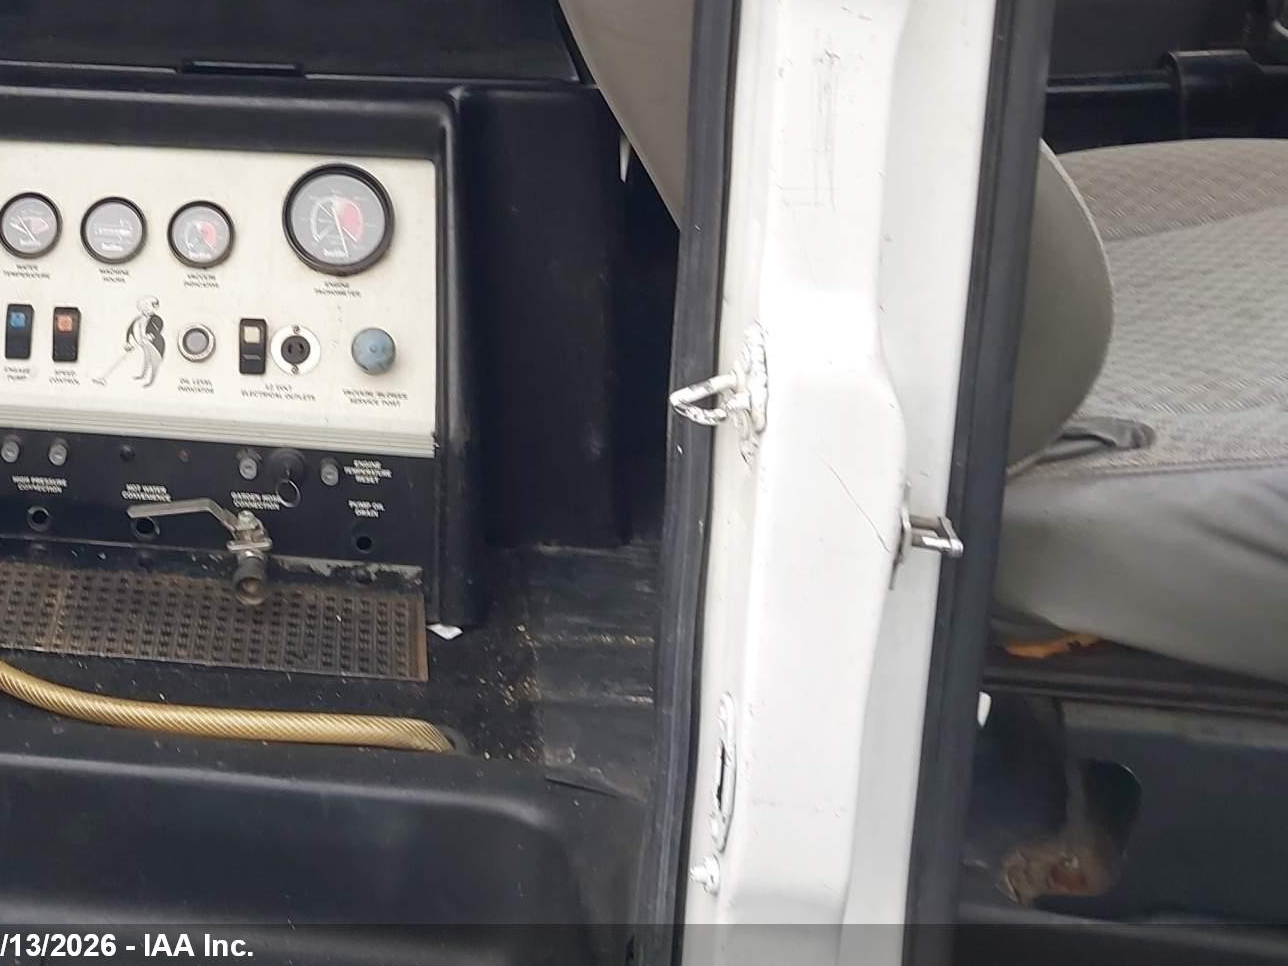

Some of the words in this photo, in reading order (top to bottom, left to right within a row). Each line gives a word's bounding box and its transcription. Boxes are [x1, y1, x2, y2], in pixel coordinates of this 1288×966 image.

[30, 476, 68, 487] PRESSURE
[125, 483, 141, 493] HOT
[142, 485, 167, 495] WATER
[232, 500, 281, 511] CONNECTION
